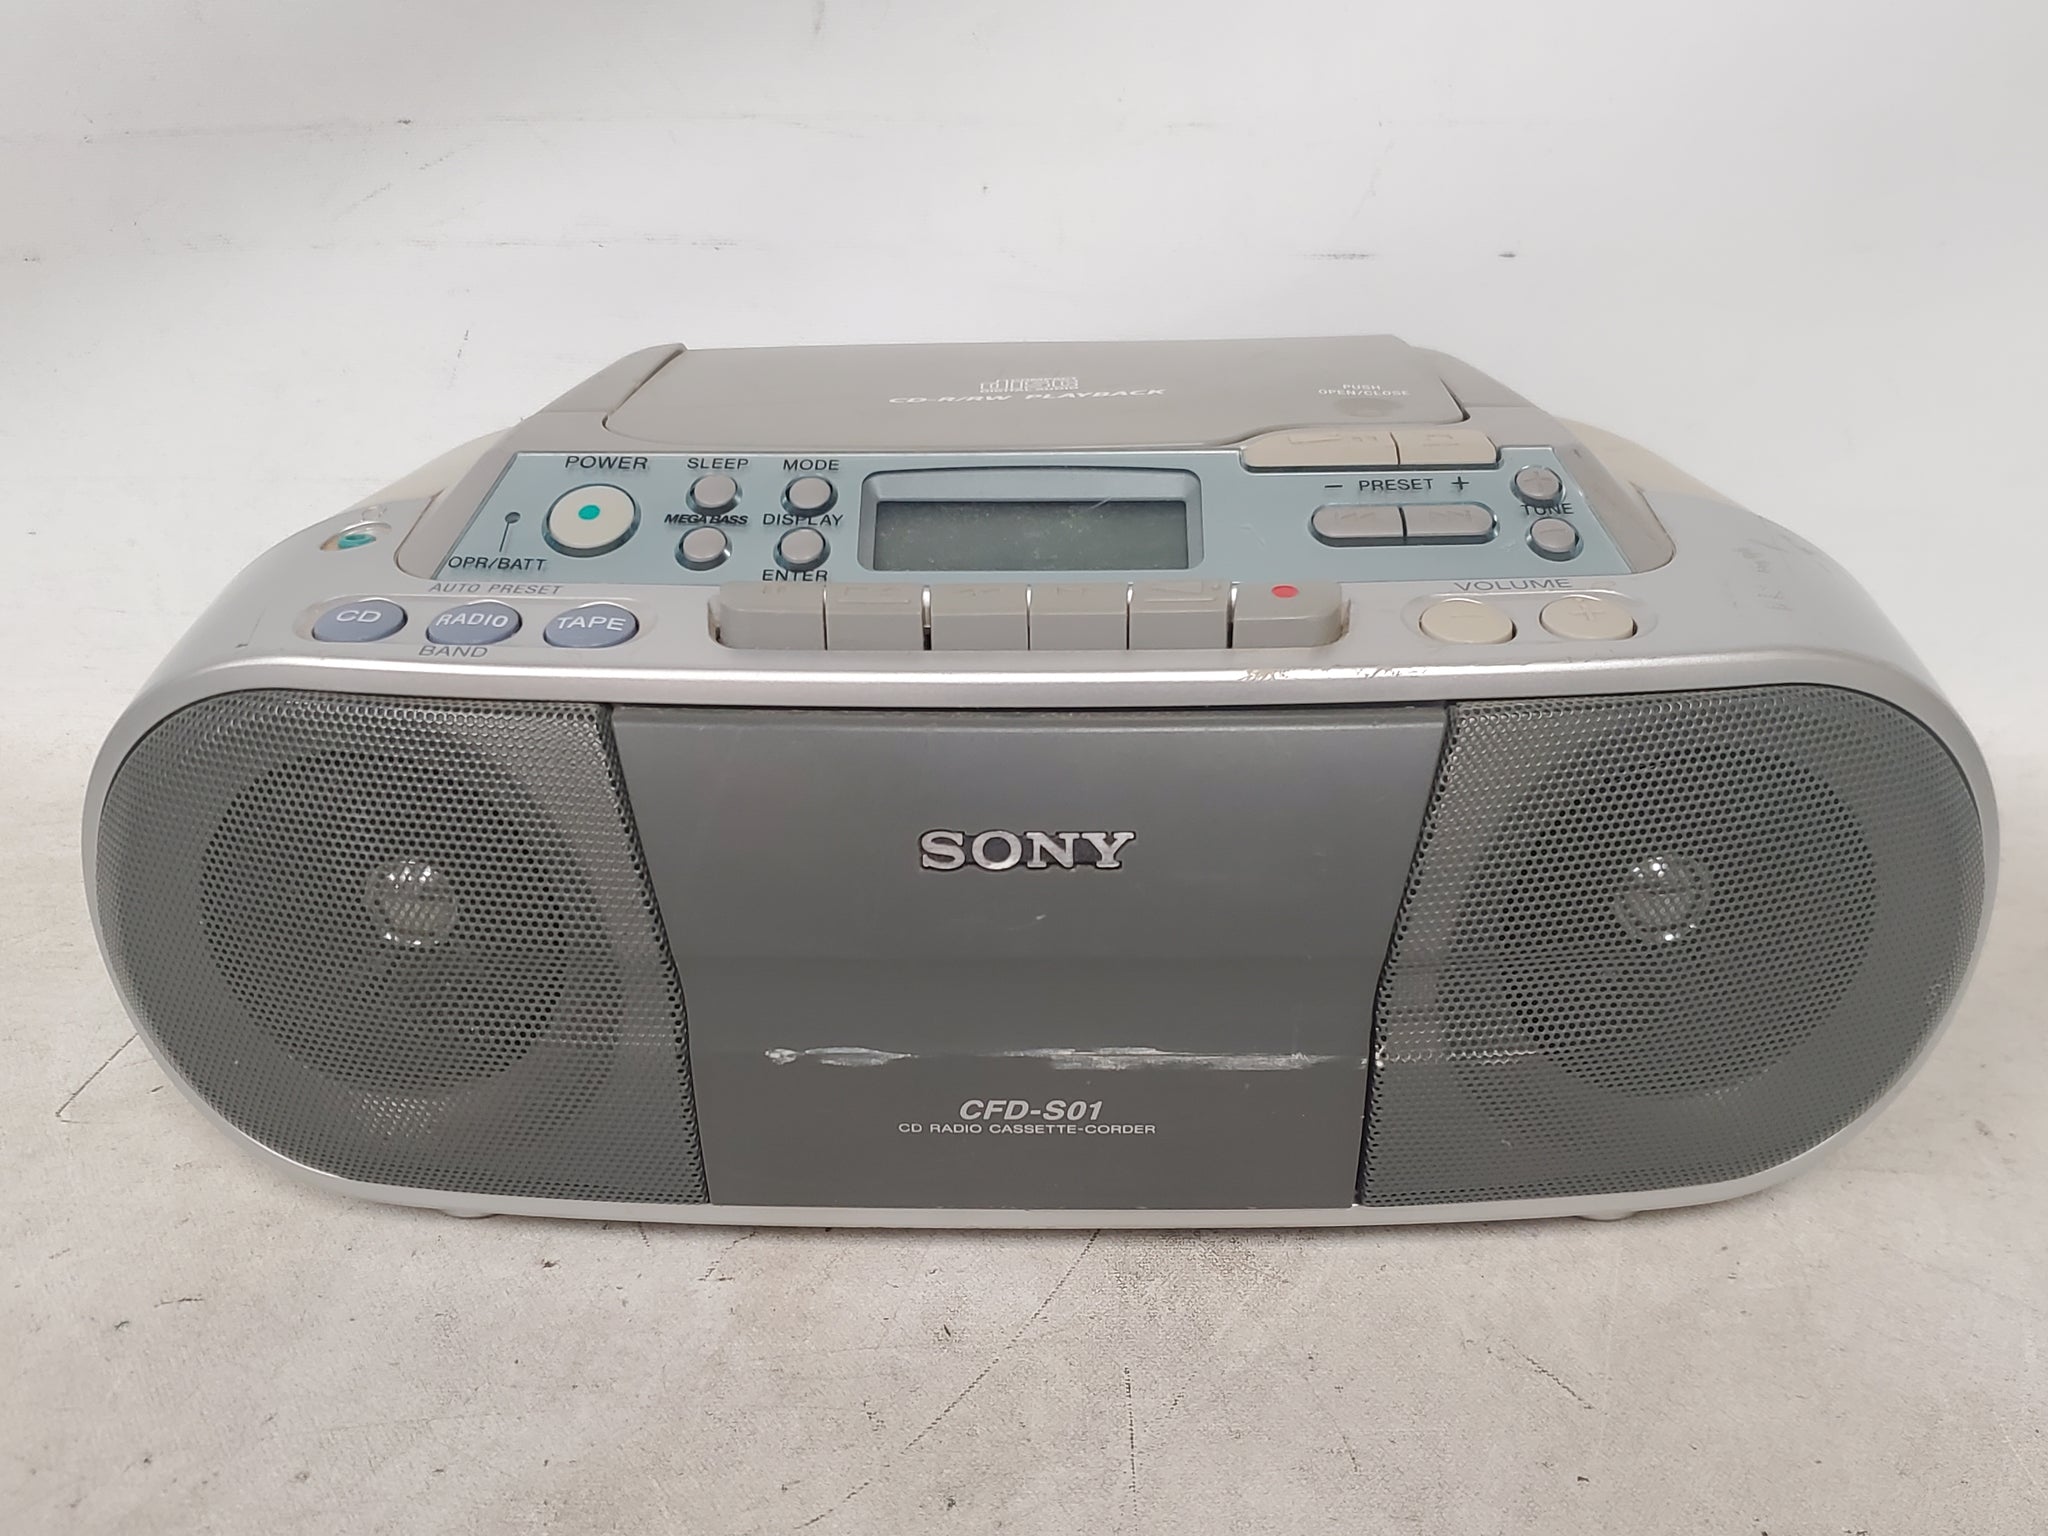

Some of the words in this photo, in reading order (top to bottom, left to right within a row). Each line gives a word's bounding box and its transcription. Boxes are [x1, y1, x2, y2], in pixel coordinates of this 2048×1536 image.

[888, 395, 1012, 404] CD-R/RW
[1025, 388, 1167, 400] PLAYBACK
[1318, 388, 1410, 396] OPEN/CLOSE
[565, 456, 648, 470] POWER
[687, 457, 749, 470] SLEEP
[783, 459, 840, 471] MODE
[1359, 478, 1434, 491] PRESET
[763, 513, 844, 526] DISPLAY
[448, 556, 548, 571] OPR/BATT
[762, 569, 829, 582] ENTER
[429, 583, 480, 594] AUTO
[487, 584, 563, 595] PRESET
[1454, 578, 1573, 592] VOLUME
[336, 610, 382, 623] CD
[435, 613, 509, 628] RADIO
[556, 616, 627, 631] TAPE
[418, 645, 488, 658] BAND
[919, 829, 1135, 870] SONY
[959, 1100, 1102, 1121] CFD-S01
[898, 1123, 923, 1133] CD
[930, 1124, 982, 1133] RADIO
[989, 1124, 1156, 1134] CASSETTE-CORDER
